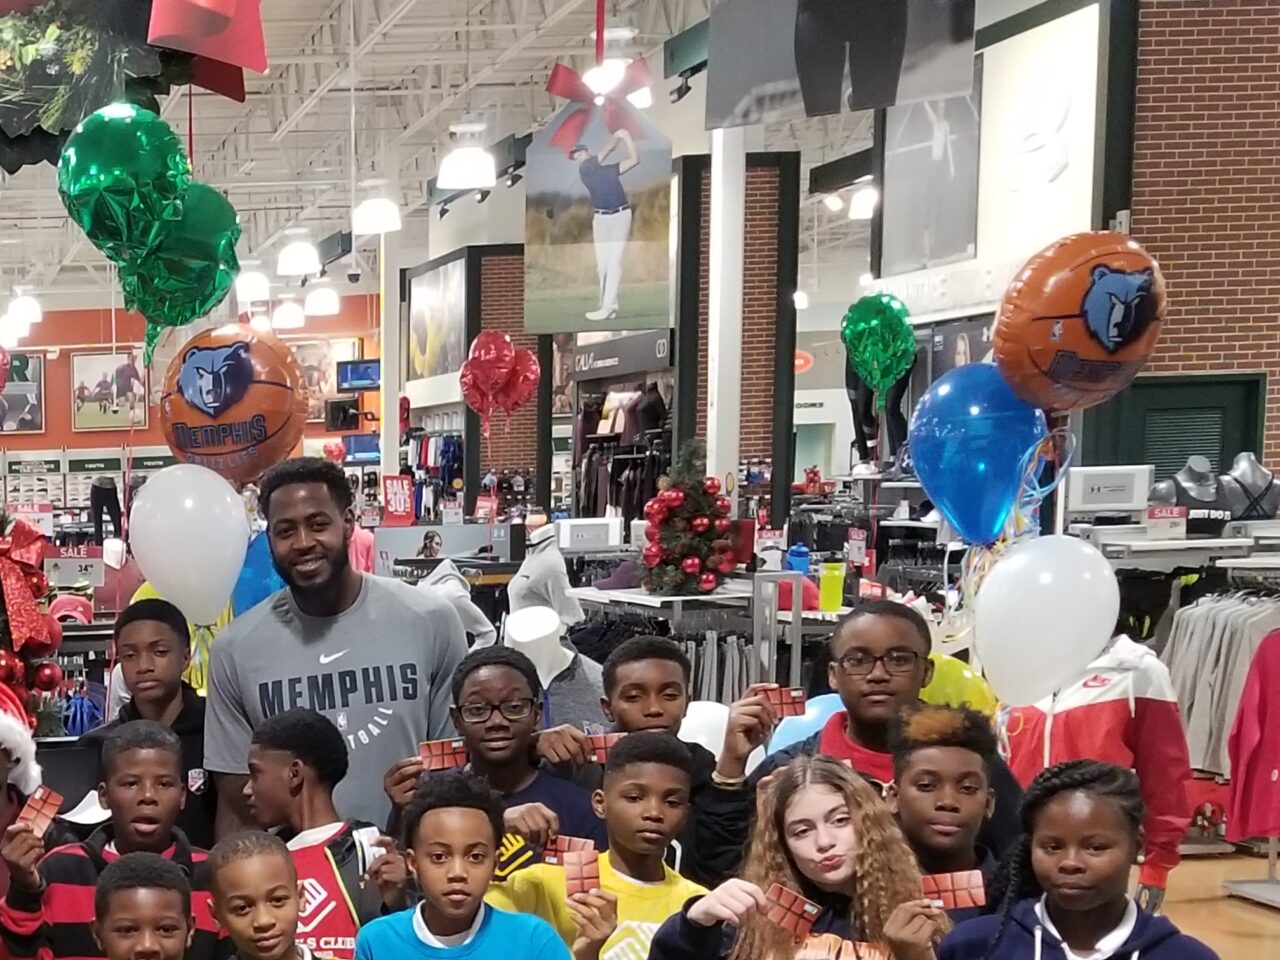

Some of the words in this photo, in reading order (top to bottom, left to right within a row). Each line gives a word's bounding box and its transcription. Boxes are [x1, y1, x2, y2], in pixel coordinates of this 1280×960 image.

[172, 414, 268, 449] MEMPHIS
[386, 479, 410, 495] SALE
[1154, 508, 1180, 517] SALE
[1189, 509, 1209, 519] JUST
[1210, 510, 1224, 519] DO
[60, 547, 87, 558] SALE
[258, 663, 418, 720] MEMPHIS
[347, 707, 393, 749] TBALL
[320, 936, 356, 949] CLUB
